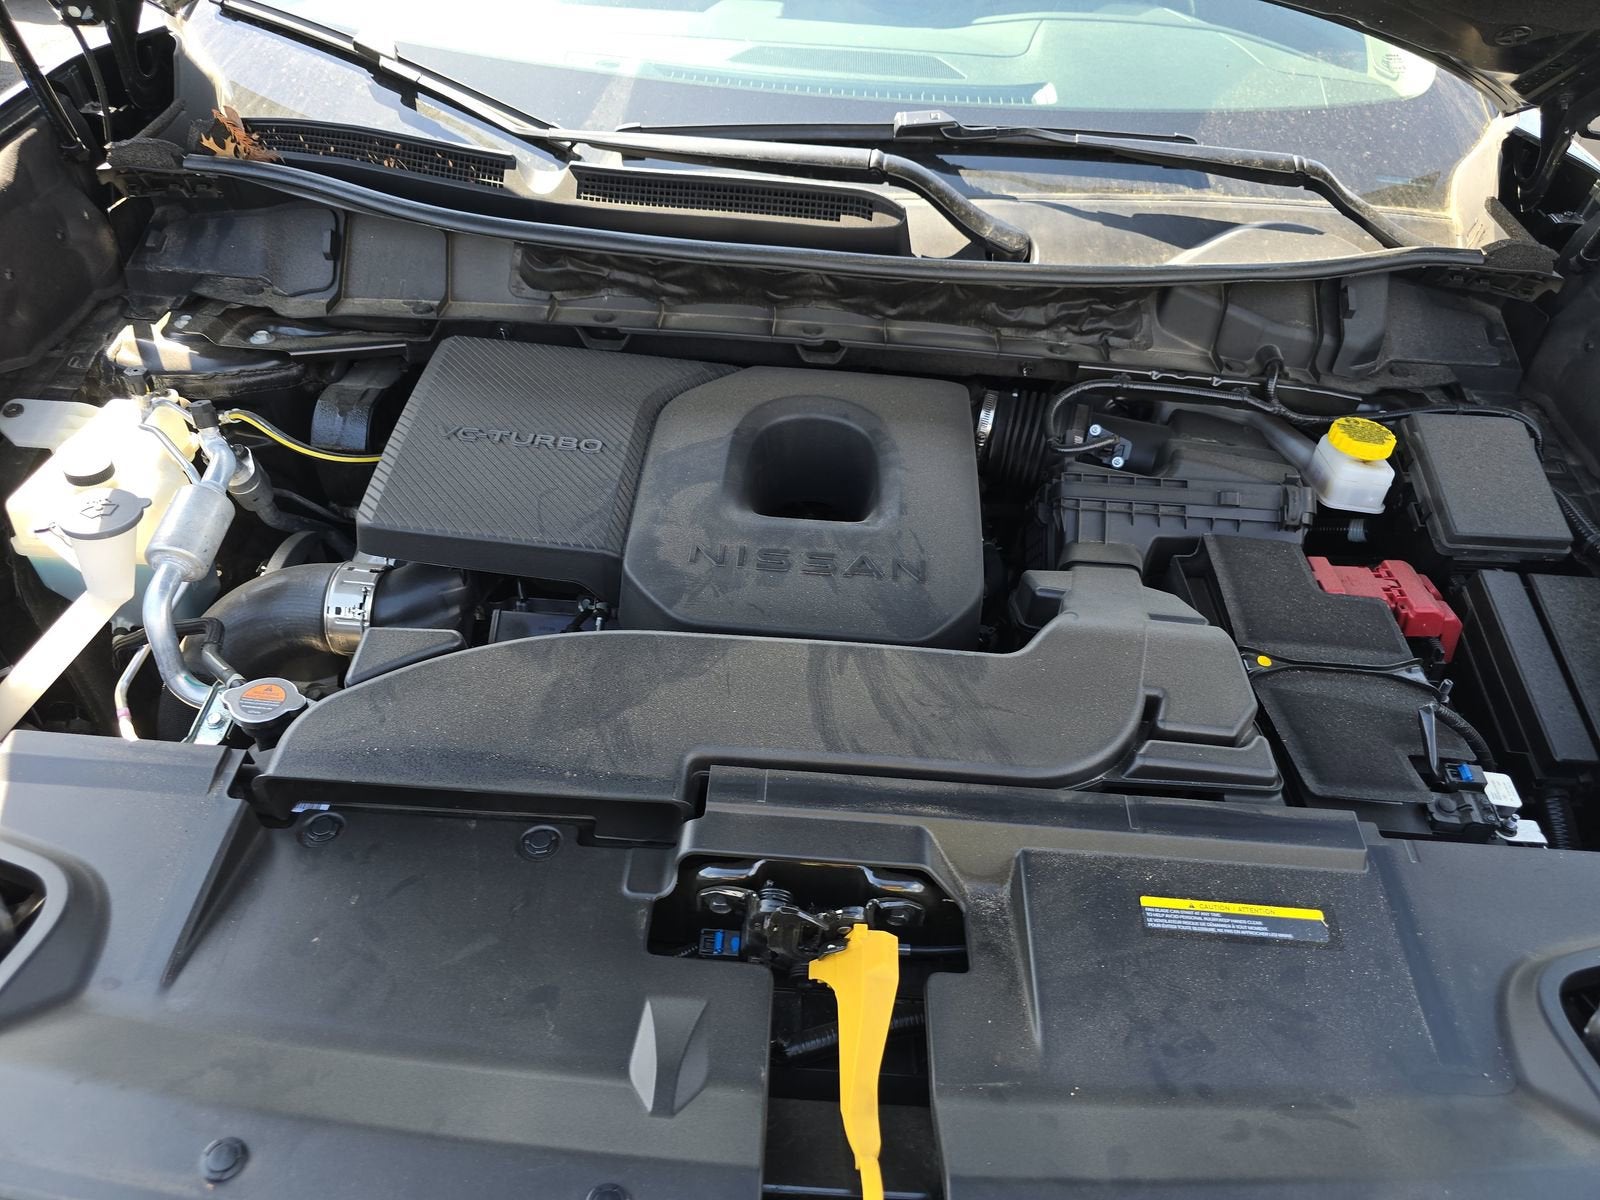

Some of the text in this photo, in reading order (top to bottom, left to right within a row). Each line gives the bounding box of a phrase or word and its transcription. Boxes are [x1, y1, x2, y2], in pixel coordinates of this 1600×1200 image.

[688, 543, 927, 584] NISSAN
[1199, 903, 1230, 911] CAUTION
[1238, 906, 1275, 915] ATTENTION
